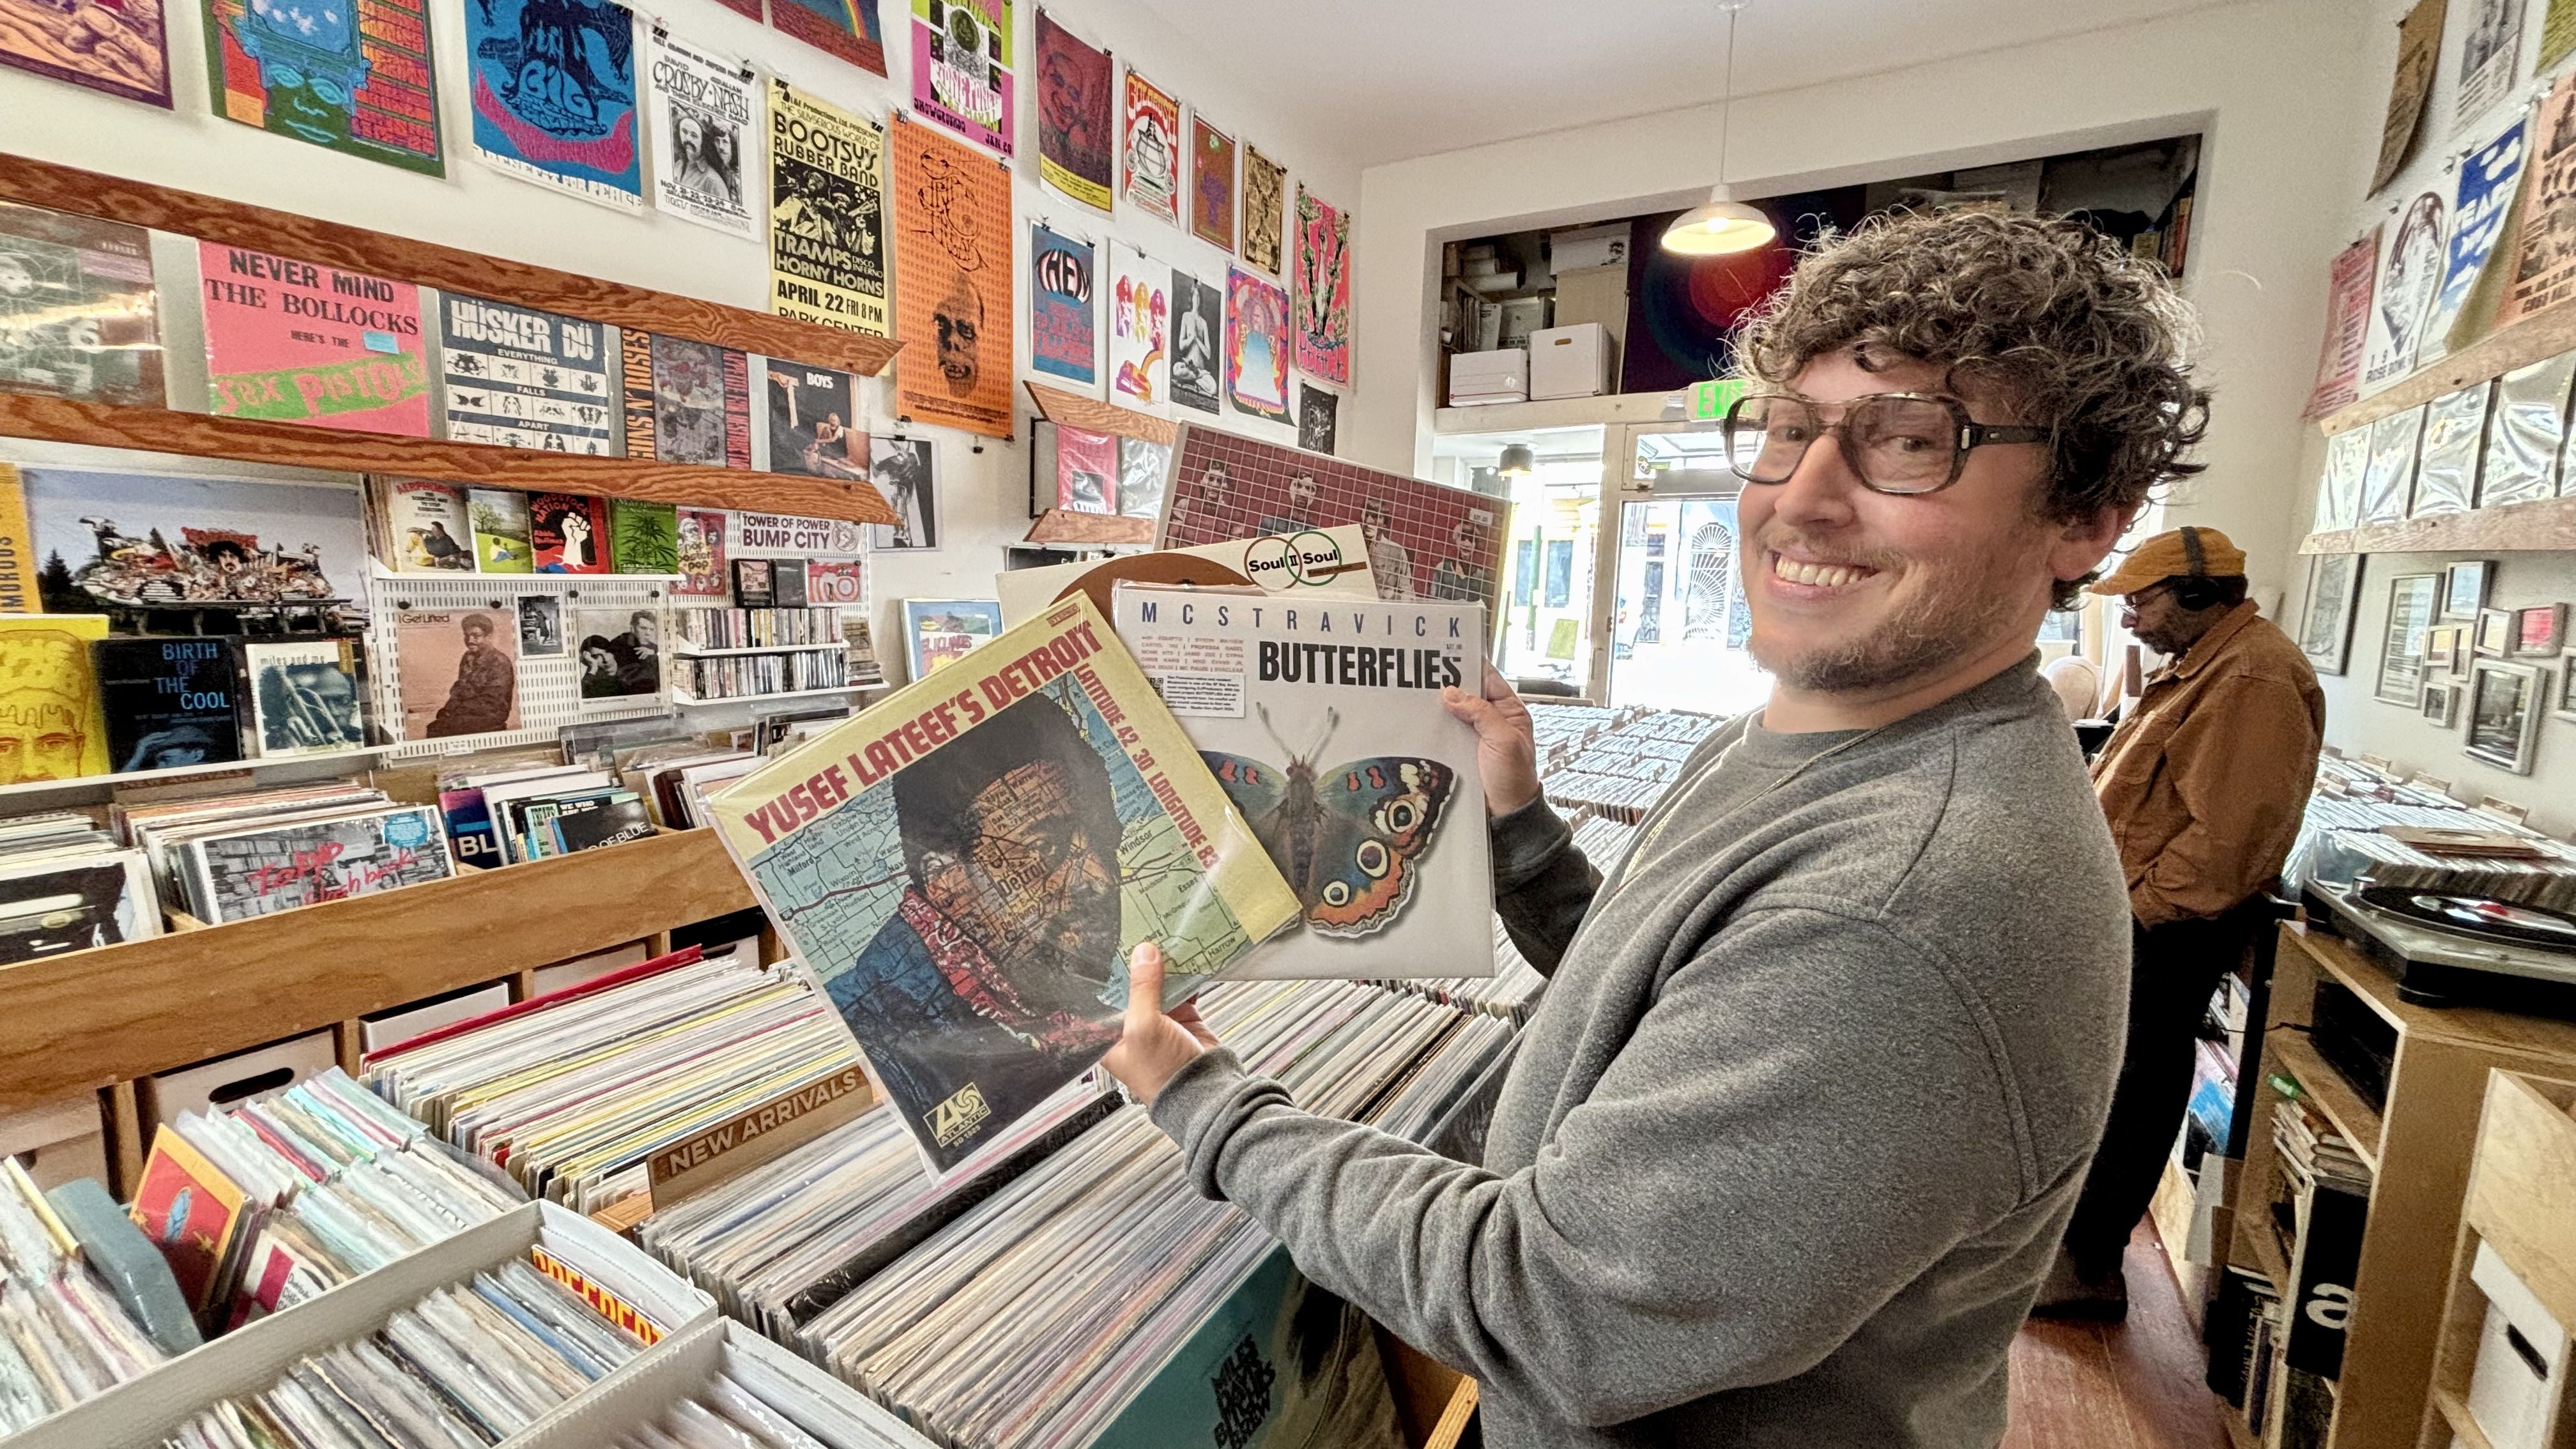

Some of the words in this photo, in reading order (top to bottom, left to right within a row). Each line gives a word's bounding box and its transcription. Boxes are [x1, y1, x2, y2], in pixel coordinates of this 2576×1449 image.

[664, 54, 689, 71] DAVID
[653, 61, 709, 101] CROSBY
[712, 83, 750, 121] NASH
[780, 101, 795, 116] THE
[842, 129, 868, 146] WORLD
[870, 141, 880, 151] OF
[849, 123, 880, 142] PRESENTS
[774, 135, 835, 172] RUBBER
[839, 164, 878, 187] BAND
[660, 179, 678, 193] NOV.
[774, 229, 852, 271] TRAMPS
[852, 255, 875, 268] DISCO
[852, 263, 884, 279] INFERNO
[228, 249, 320, 289] NEVER
[331, 270, 395, 303] MIND
[776, 253, 831, 282] HORNY
[833, 270, 884, 297] HORNS
[205, 278, 267, 309] THE
[282, 292, 419, 336] BOLLOCKS
[777, 279, 821, 308] APRIL
[824, 292, 845, 314] 22
[846, 298, 859, 317] FRI
[861, 303, 867, 319] 8
[868, 305, 883, 324] PM
[290, 330, 326, 345] HERE'S
[332, 335, 350, 349] THE
[450, 299, 553, 354] HÜSKER
[561, 322, 594, 361] DÜ
[496, 348, 559, 366] EVERYTHING
[622, 328, 654, 392] ROSES
[516, 385, 547, 397] FALLS
[806, 371, 834, 390] BOYS
[518, 420, 550, 431] APART
[535, 501, 570, 523] NATION
[742, 514, 778, 528] TOWER
[781, 518, 794, 529] OF
[797, 518, 831, 531] POWER
[742, 528, 792, 549] BUMP
[794, 530, 831, 549] CITY
[1248, 556, 1285, 572] Soul
[1288, 555, 1299, 567] II
[1302, 549, 1338, 565] Soul
[402, 614, 422, 624] Get
[423, 613, 450, 624] Lifted
[162, 642, 218, 661] BIRTH
[259, 653, 287, 666] miles
[289, 653, 308, 665] and
[310, 654, 326, 664] me
[175, 659, 200, 677] OF
[1259, 641, 1462, 691] BUTTERFLIES
[155, 676, 192, 695] THE
[180, 692, 231, 710] COOL
[743, 763, 849, 845] YUSEF
[847, 688, 986, 788] LATEEF'S
[978, 620, 1103, 711] DETROIT
[1073, 662, 1126, 728] LATITUDE
[1147, 770, 1208, 849] LONGITUDE
[615, 821, 650, 844] BLUE
[843, 836, 862, 848] West
[1119, 829, 1155, 855] Windsor
[786, 857, 815, 878] Milford
[830, 869, 858, 888] Wixom
[843, 891, 870, 910] Hudson
[1207, 935, 1237, 958] Harrow
[668, 1128, 735, 1177] NEW
[741, 1070, 858, 1144] ARRIVALS
[940, 1105, 988, 1144] ATLANTIC
